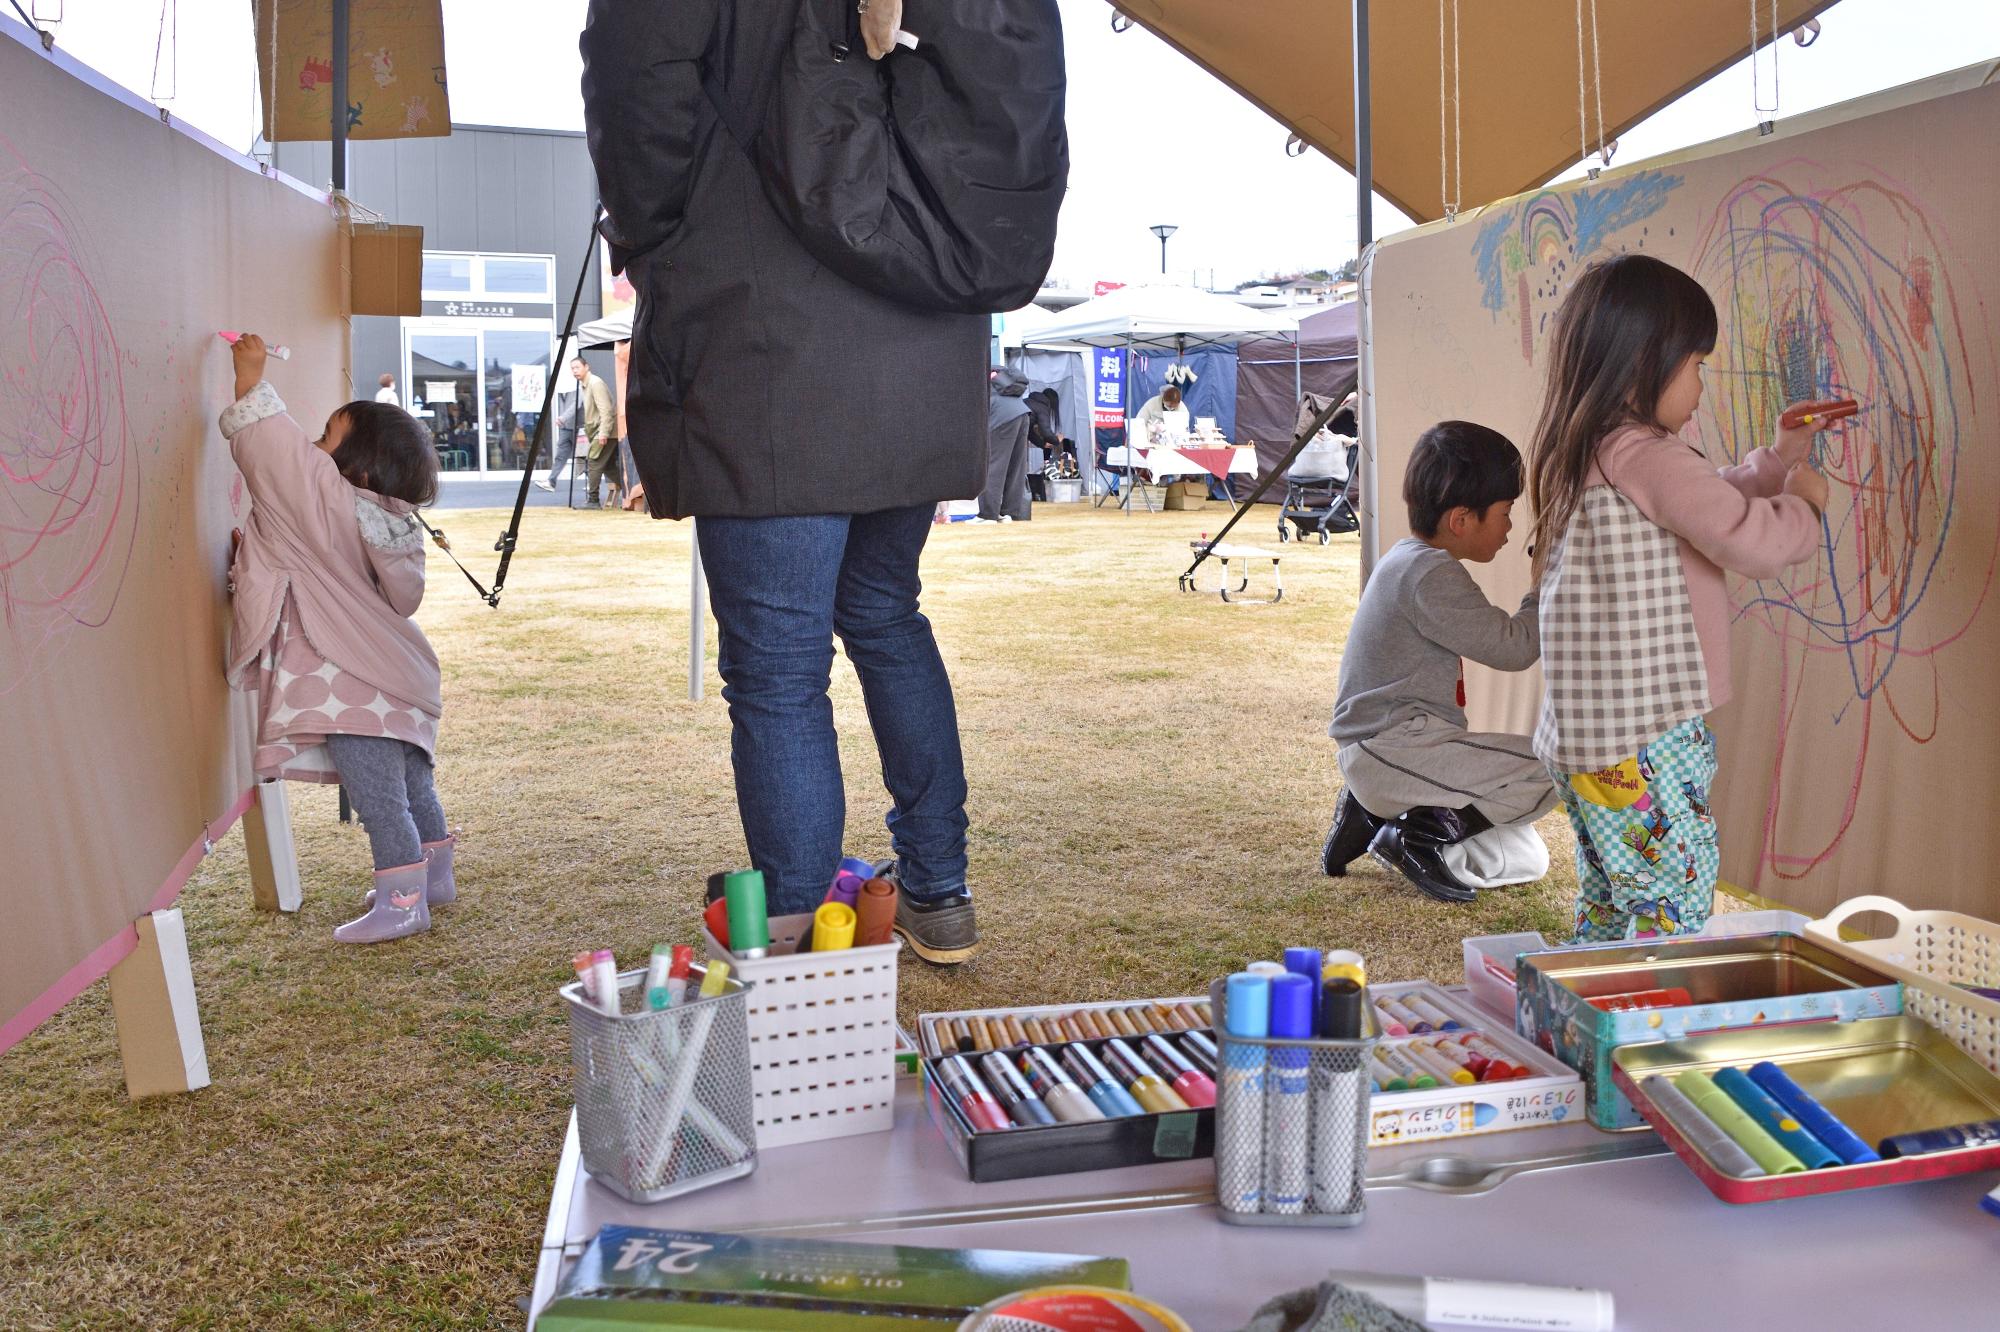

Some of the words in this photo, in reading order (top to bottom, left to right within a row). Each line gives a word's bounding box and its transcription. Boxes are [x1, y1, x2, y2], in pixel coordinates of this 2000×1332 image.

[1098, 348, 1121, 404] 料理
[1095, 413, 1124, 423] ELCOM
[1408, 1105, 1456, 1121] クレヨン
[612, 1237, 714, 1275] 24
[756, 1269, 846, 1286] PASTEL
[860, 1277, 903, 1289] OIL
